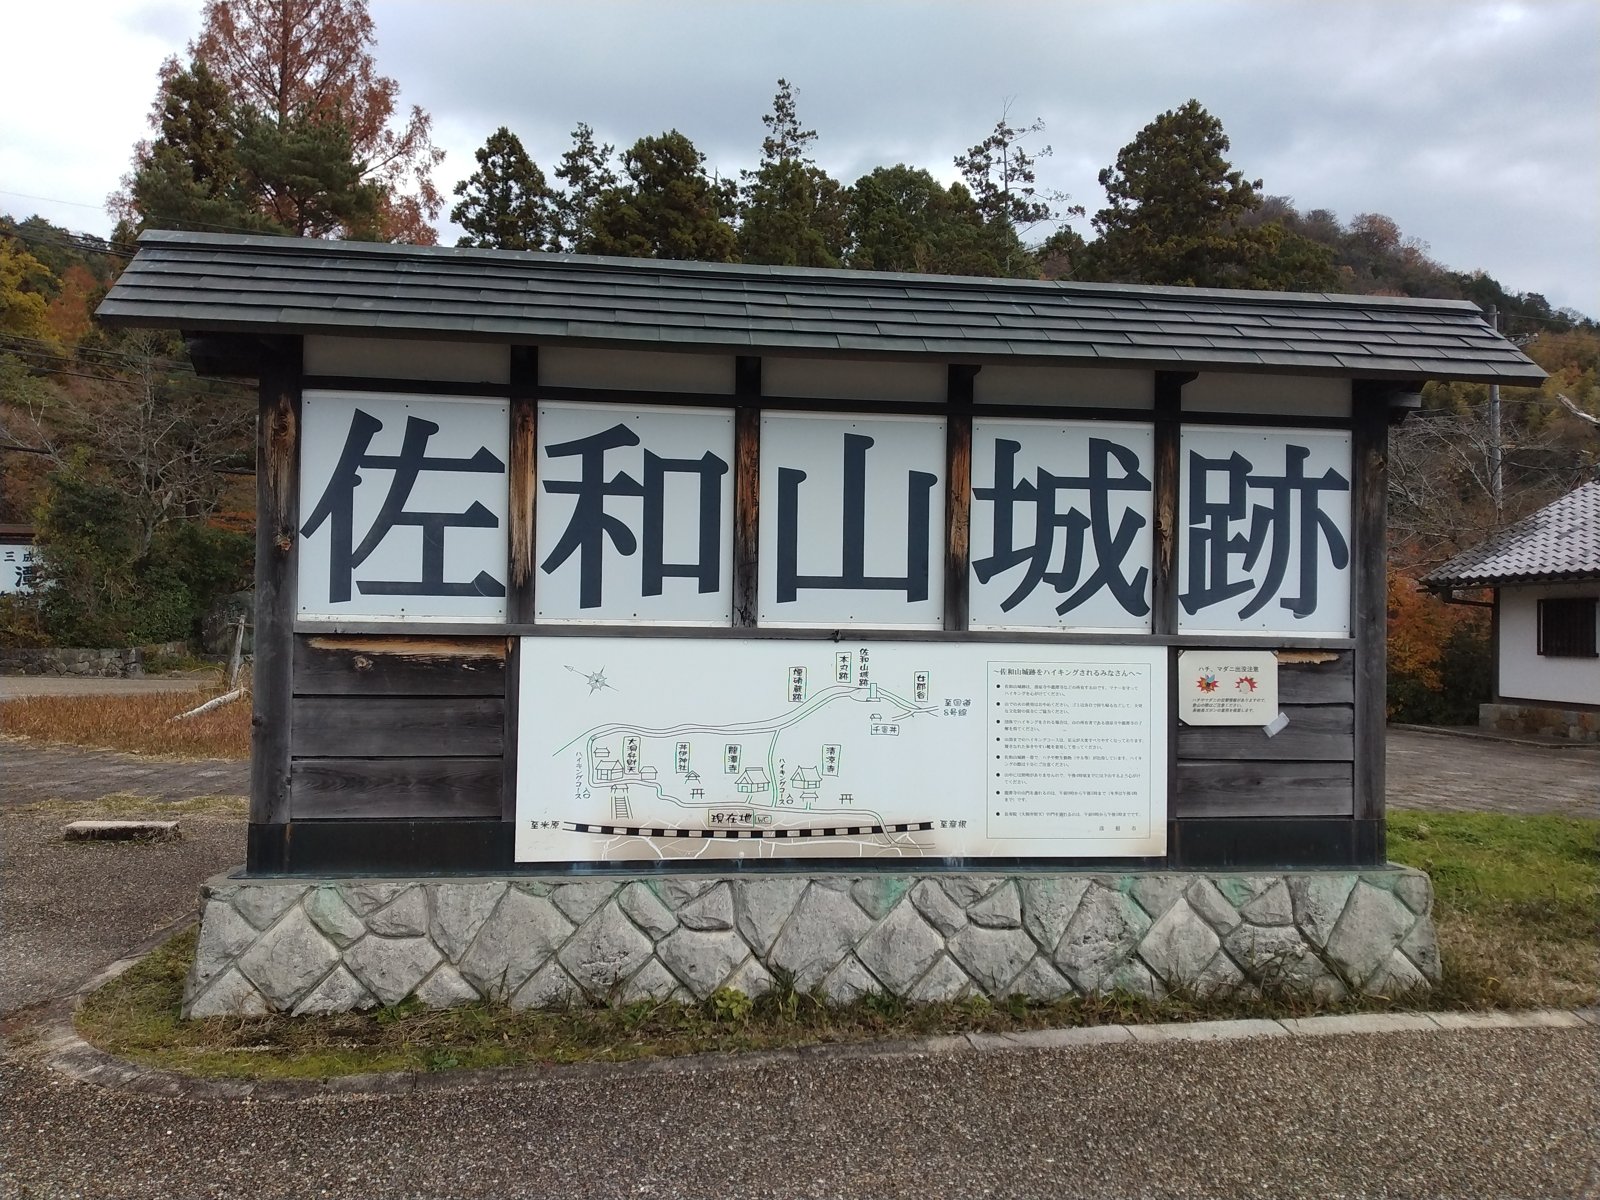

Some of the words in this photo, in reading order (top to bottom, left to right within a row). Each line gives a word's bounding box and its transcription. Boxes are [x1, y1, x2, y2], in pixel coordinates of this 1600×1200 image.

[300, 408, 1349, 621] 佐和山城跡
[839, 655, 849, 680] 本丸跡
[859, 648, 869, 686] 佐和山城跡
[678, 744, 688, 770] 井伊神社
[575, 751, 583, 799] ハイキングコース
[583, 788, 591, 799] 入口
[779, 758, 787, 805] ハイキングコース
[786, 793, 794, 804] 入口
[531, 820, 560, 829] 至米原
[711, 813, 752, 824] 現在地
[756, 816, 769, 824] WC
